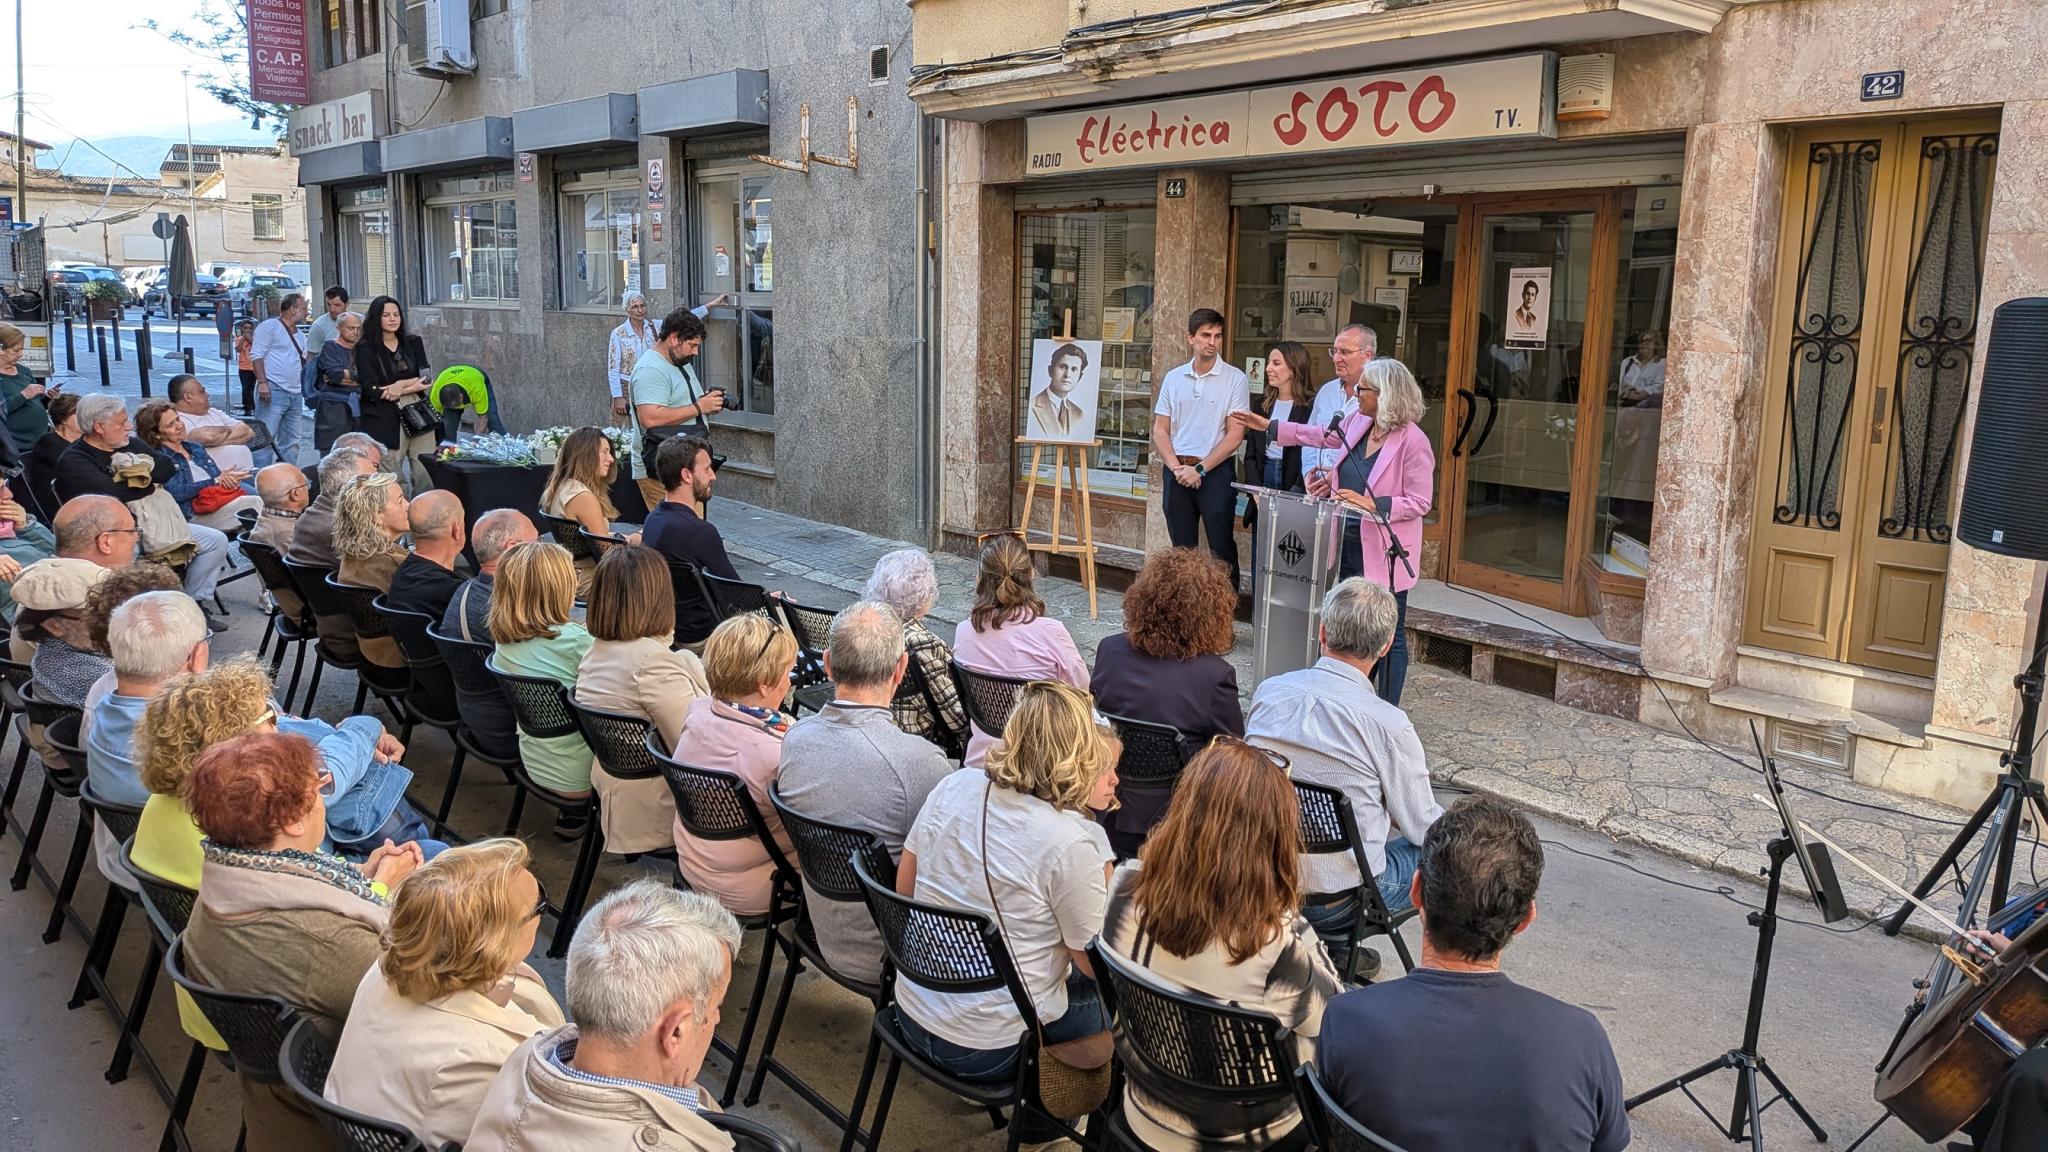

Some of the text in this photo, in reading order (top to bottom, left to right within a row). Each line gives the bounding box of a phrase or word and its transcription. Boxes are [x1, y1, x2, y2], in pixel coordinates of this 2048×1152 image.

[253, 8, 302, 22] Permisos
[257, 33, 301, 45] Peligrosas
[256, 49, 305, 67] C.A.P.
[265, 73, 298, 83] Viajeros
[1866, 75, 1896, 96] 42
[258, 87, 306, 98] Transportistas
[295, 103, 367, 150] snack bar
[1076, 75, 1457, 164] Eléctrica SOTO
[1032, 152, 1062, 169] RADIO
[1167, 182, 1182, 195] 44
[1261, 566, 1319, 587] Ajuntament d'Inca
